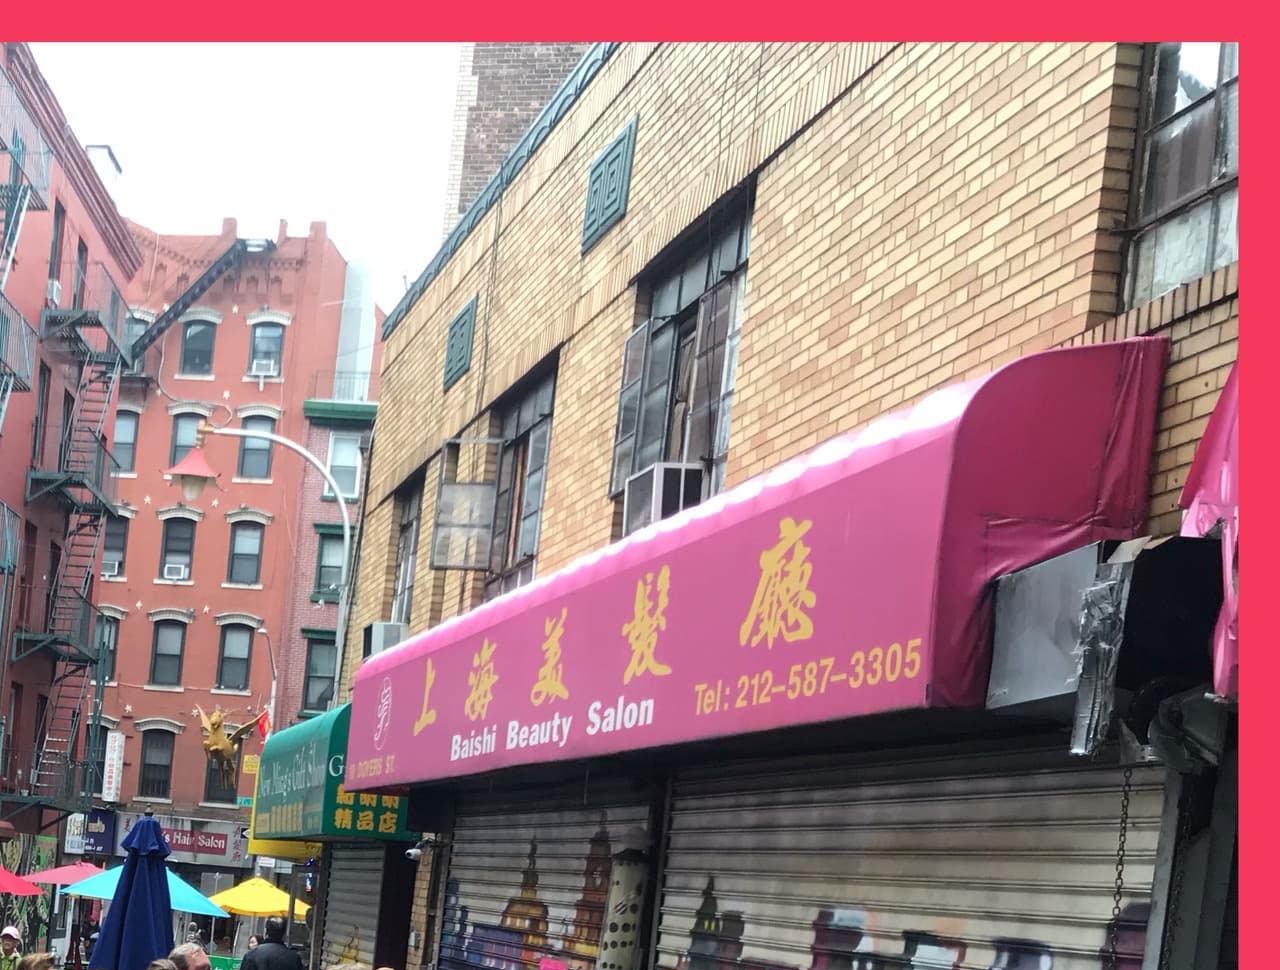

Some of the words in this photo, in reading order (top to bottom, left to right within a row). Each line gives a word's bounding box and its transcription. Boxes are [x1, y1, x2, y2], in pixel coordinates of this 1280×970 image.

[694, 682, 730, 717] Tel:
[735, 637, 923, 708] 212-587-3305
[449, 724, 497, 762] Baishi
[506, 714, 572, 751] Beauty
[587, 697, 654, 736] Salon
[356, 757, 383, 779] DOYERS
[334, 808, 398, 834] 精品店
[173, 831, 195, 846] Hair
[198, 835, 225, 849] Salon
